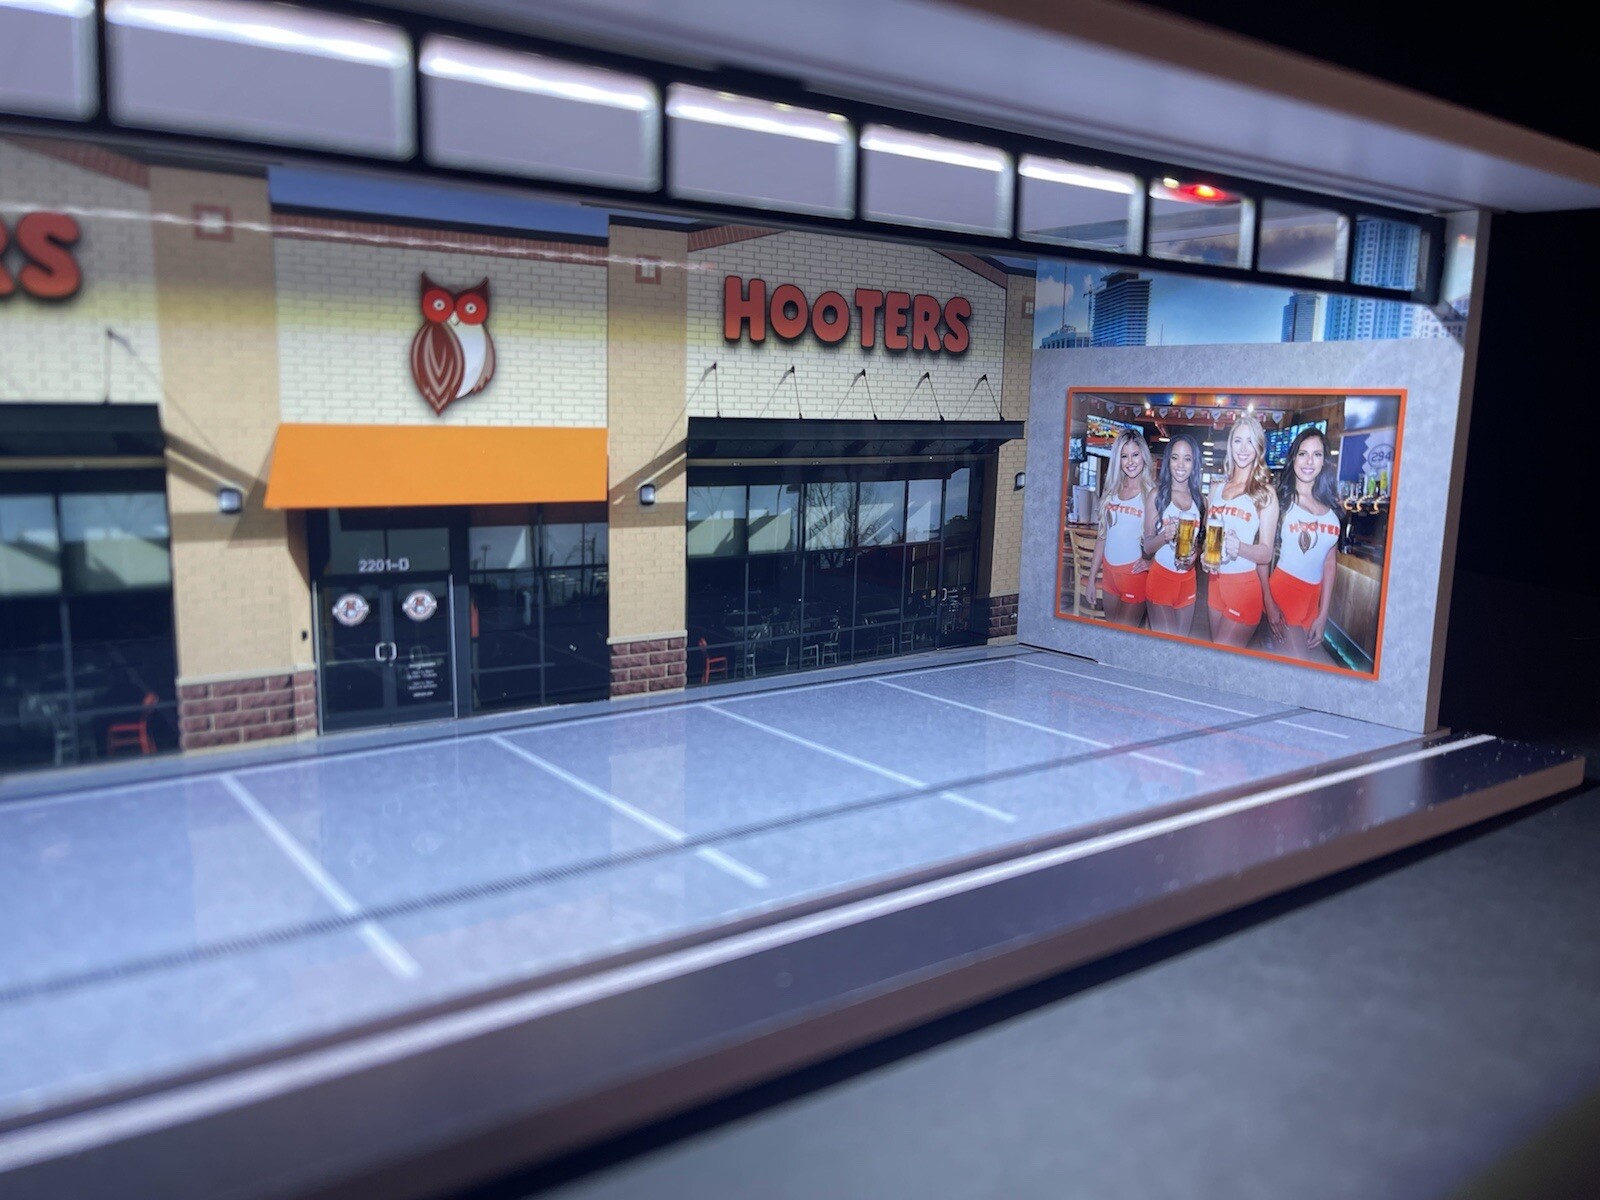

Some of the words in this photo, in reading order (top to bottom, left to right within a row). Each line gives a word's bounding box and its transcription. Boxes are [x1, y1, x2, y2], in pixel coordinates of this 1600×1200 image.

[0, 211, 81, 298] S
[724, 275, 972, 353] HOOTERS
[358, 557, 410, 573] 2201-D
